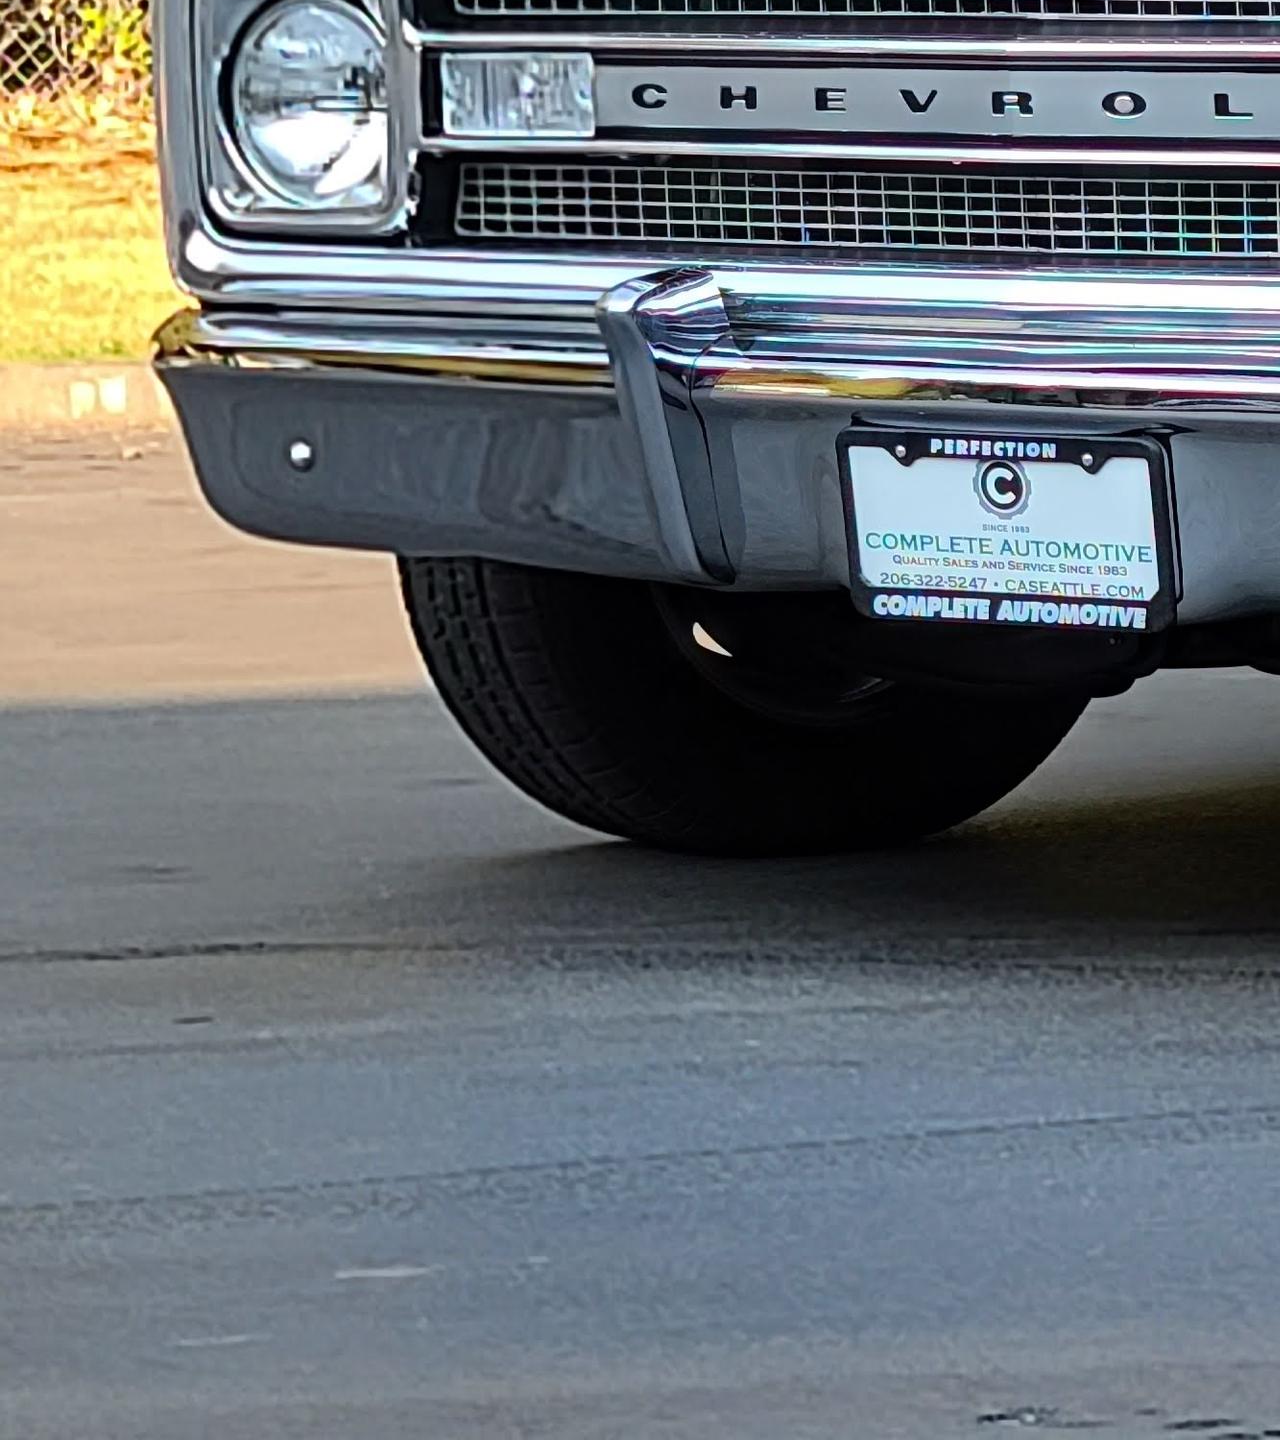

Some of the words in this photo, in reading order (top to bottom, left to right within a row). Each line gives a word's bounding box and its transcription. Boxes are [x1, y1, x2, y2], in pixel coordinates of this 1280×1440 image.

[930, 438, 1057, 459] PERFECTION
[982, 523, 1009, 533] SINCE
[865, 532, 994, 556] COMPLETE
[1000, 539, 1153, 563] AUTOMOTIVE
[892, 554, 940, 566] QUALITY
[942, 557, 979, 569] SALES
[981, 561, 1005, 570] AND
[1007, 560, 1057, 573] SERVICE
[1058, 563, 1094, 575] SINCE
[1097, 565, 1128, 577] 1983
[879, 572, 988, 590] 206-322-5247
[1004, 579, 1145, 599] CASEATTLE.COM
[872, 594, 991, 621] COMPLETE
[996, 600, 1147, 629] AUTOMOTIVE
